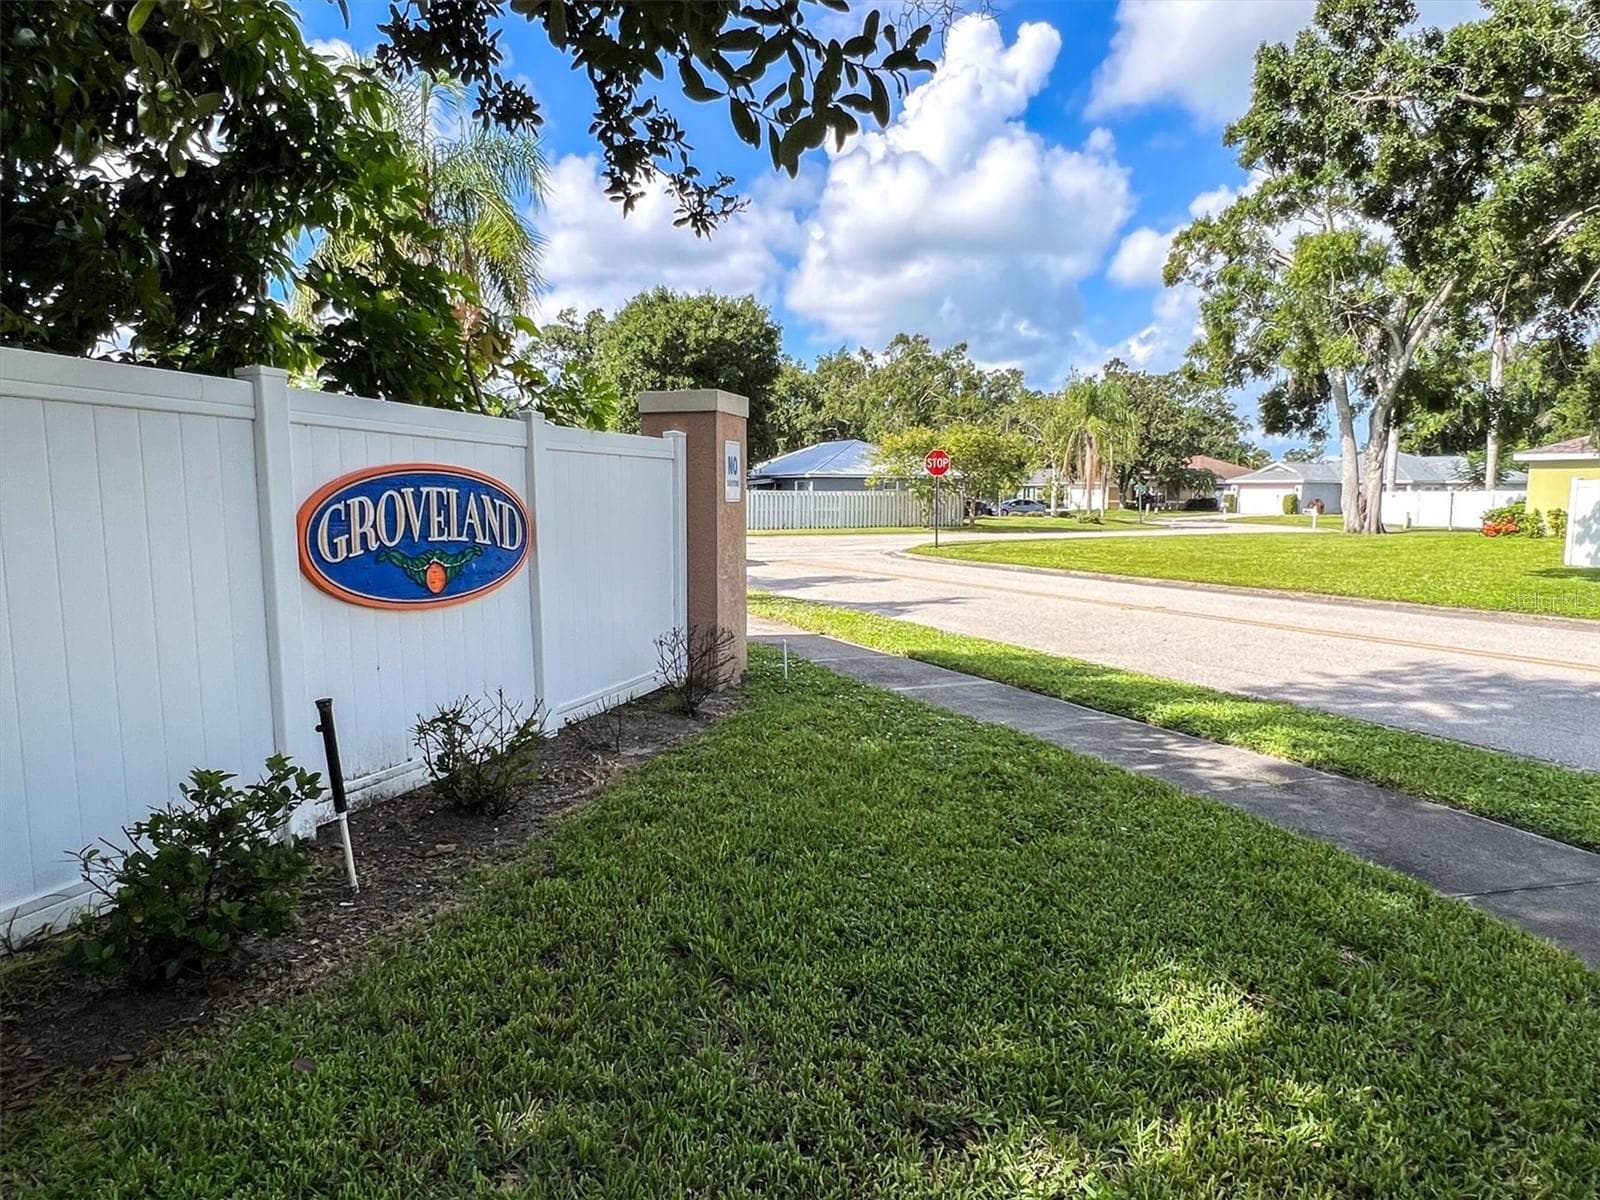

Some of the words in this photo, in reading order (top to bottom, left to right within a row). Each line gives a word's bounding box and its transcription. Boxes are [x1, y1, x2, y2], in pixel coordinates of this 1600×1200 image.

[727, 456, 738, 475] NO
[927, 457, 949, 469] STOP
[317, 487, 523, 564] GROVELAND
